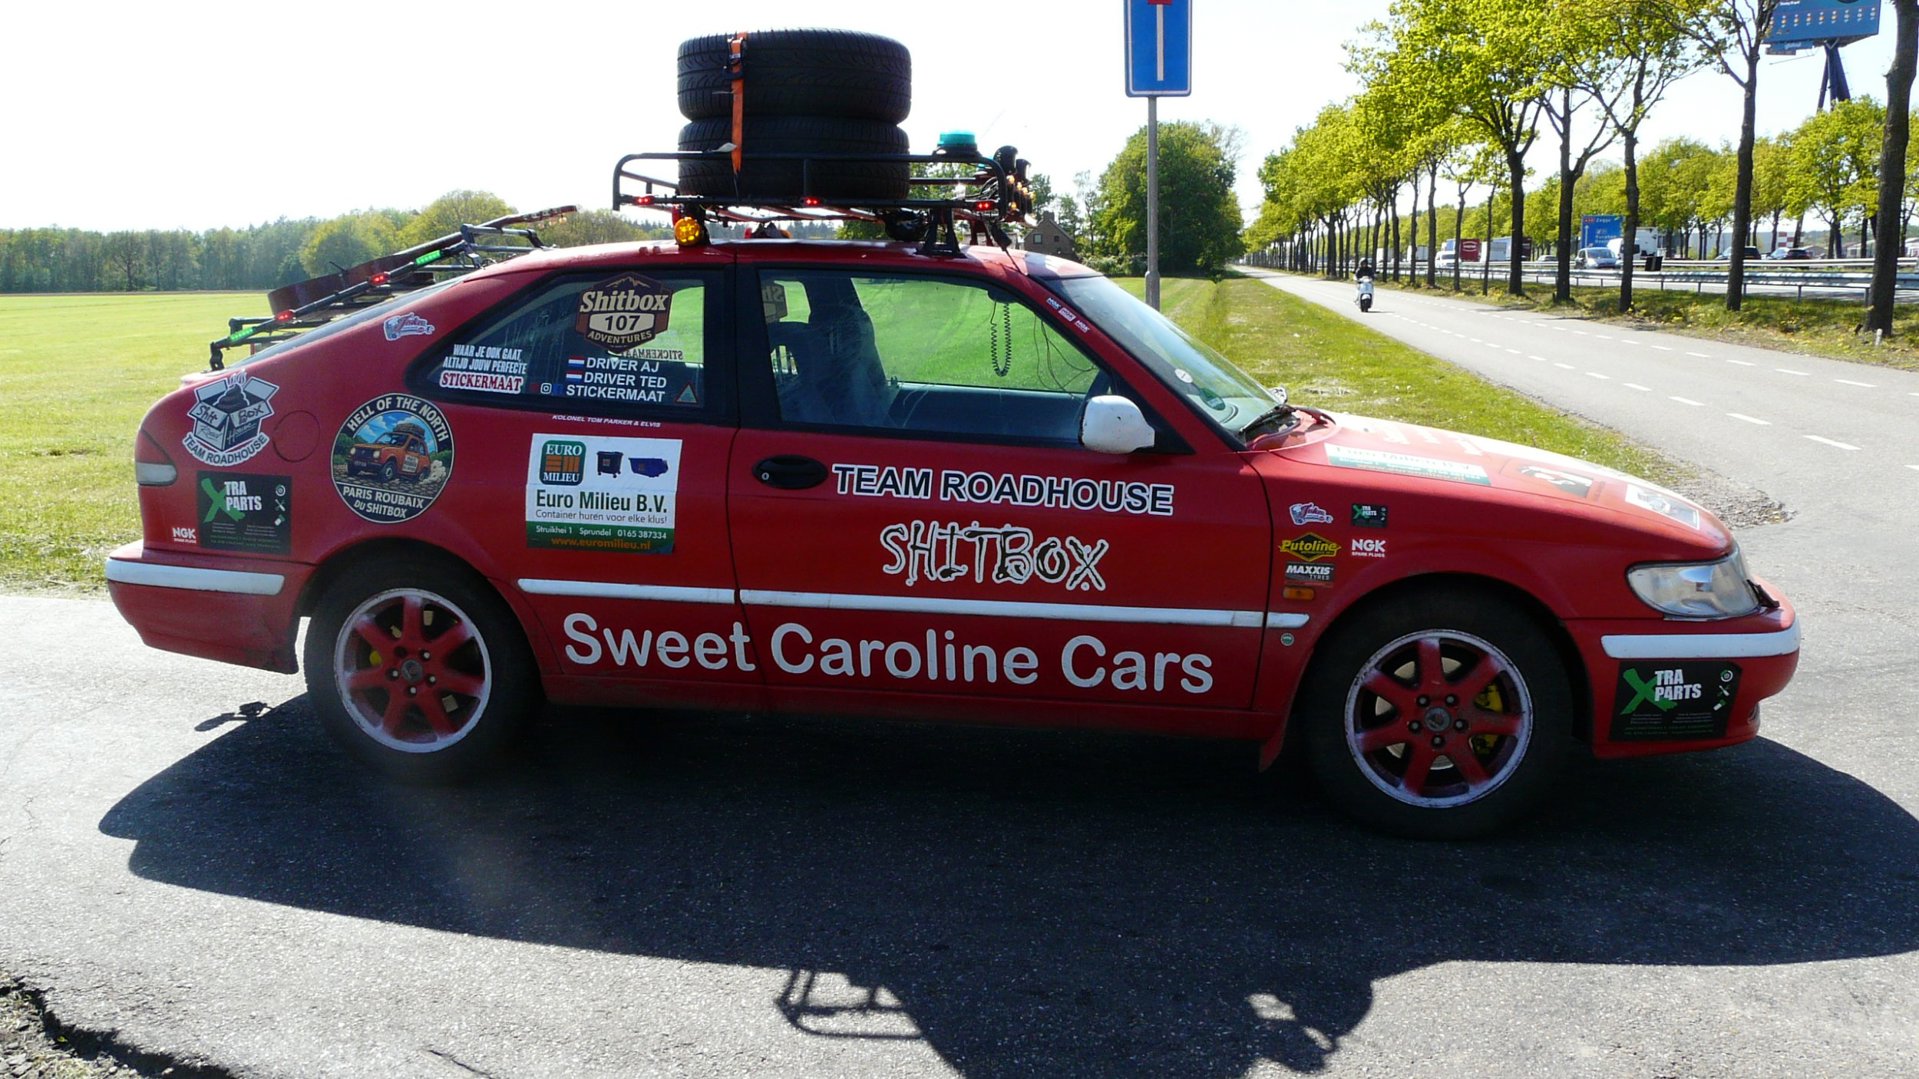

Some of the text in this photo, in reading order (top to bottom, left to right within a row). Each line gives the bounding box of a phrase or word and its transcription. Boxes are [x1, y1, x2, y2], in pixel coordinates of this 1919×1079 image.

[580, 290, 669, 312] Shitbox
[605, 315, 640, 331] 107
[587, 331, 652, 344] ADVENTURES
[453, 344, 475, 357] WAAR
[475, 346, 486, 358] JE
[486, 347, 501, 359] OOK
[443, 356, 527, 375] ALTIJD JOUW PERFECTE
[586, 357, 660, 373] DRIVER AJ
[441, 372, 522, 392] STICKERMAAT
[584, 372, 667, 388] DRIVER TED
[566, 384, 666, 402] STICKERMAAT
[347, 396, 449, 442] HELL OF THE NORTH
[552, 415, 585, 423] KOLONEL
[184, 434, 267, 465] TEAM ROADHOUSE
[546, 444, 583, 456] EURO
[543, 472, 580, 482] MILIEU
[342, 486, 424, 509] PARIS ROUBAIX
[832, 464, 1175, 516] TEAM ROADHOUSE
[226, 496, 262, 511] PARTS
[353, 500, 407, 518] DU SHITBOX
[536, 489, 667, 513] Euro Milieu B.V.
[535, 509, 577, 519] Container
[579, 511, 603, 520] huren
[628, 514, 645, 522] elke
[647, 514, 668, 524] klus!
[172, 526, 196, 540] NGK
[579, 527, 611, 536] Sprundel
[617, 529, 637, 538] 0165
[638, 530, 667, 539] 387334
[551, 537, 652, 550] www.euromilieu.nl
[1281, 540, 1338, 552] Putoline
[1352, 539, 1386, 552] NGK
[880, 520, 1109, 591] SHITBOX
[1286, 564, 1331, 575] MAXXIS
[563, 613, 1214, 694] Sweet Caroline Cars
[1654, 683, 1702, 701] PARTS
